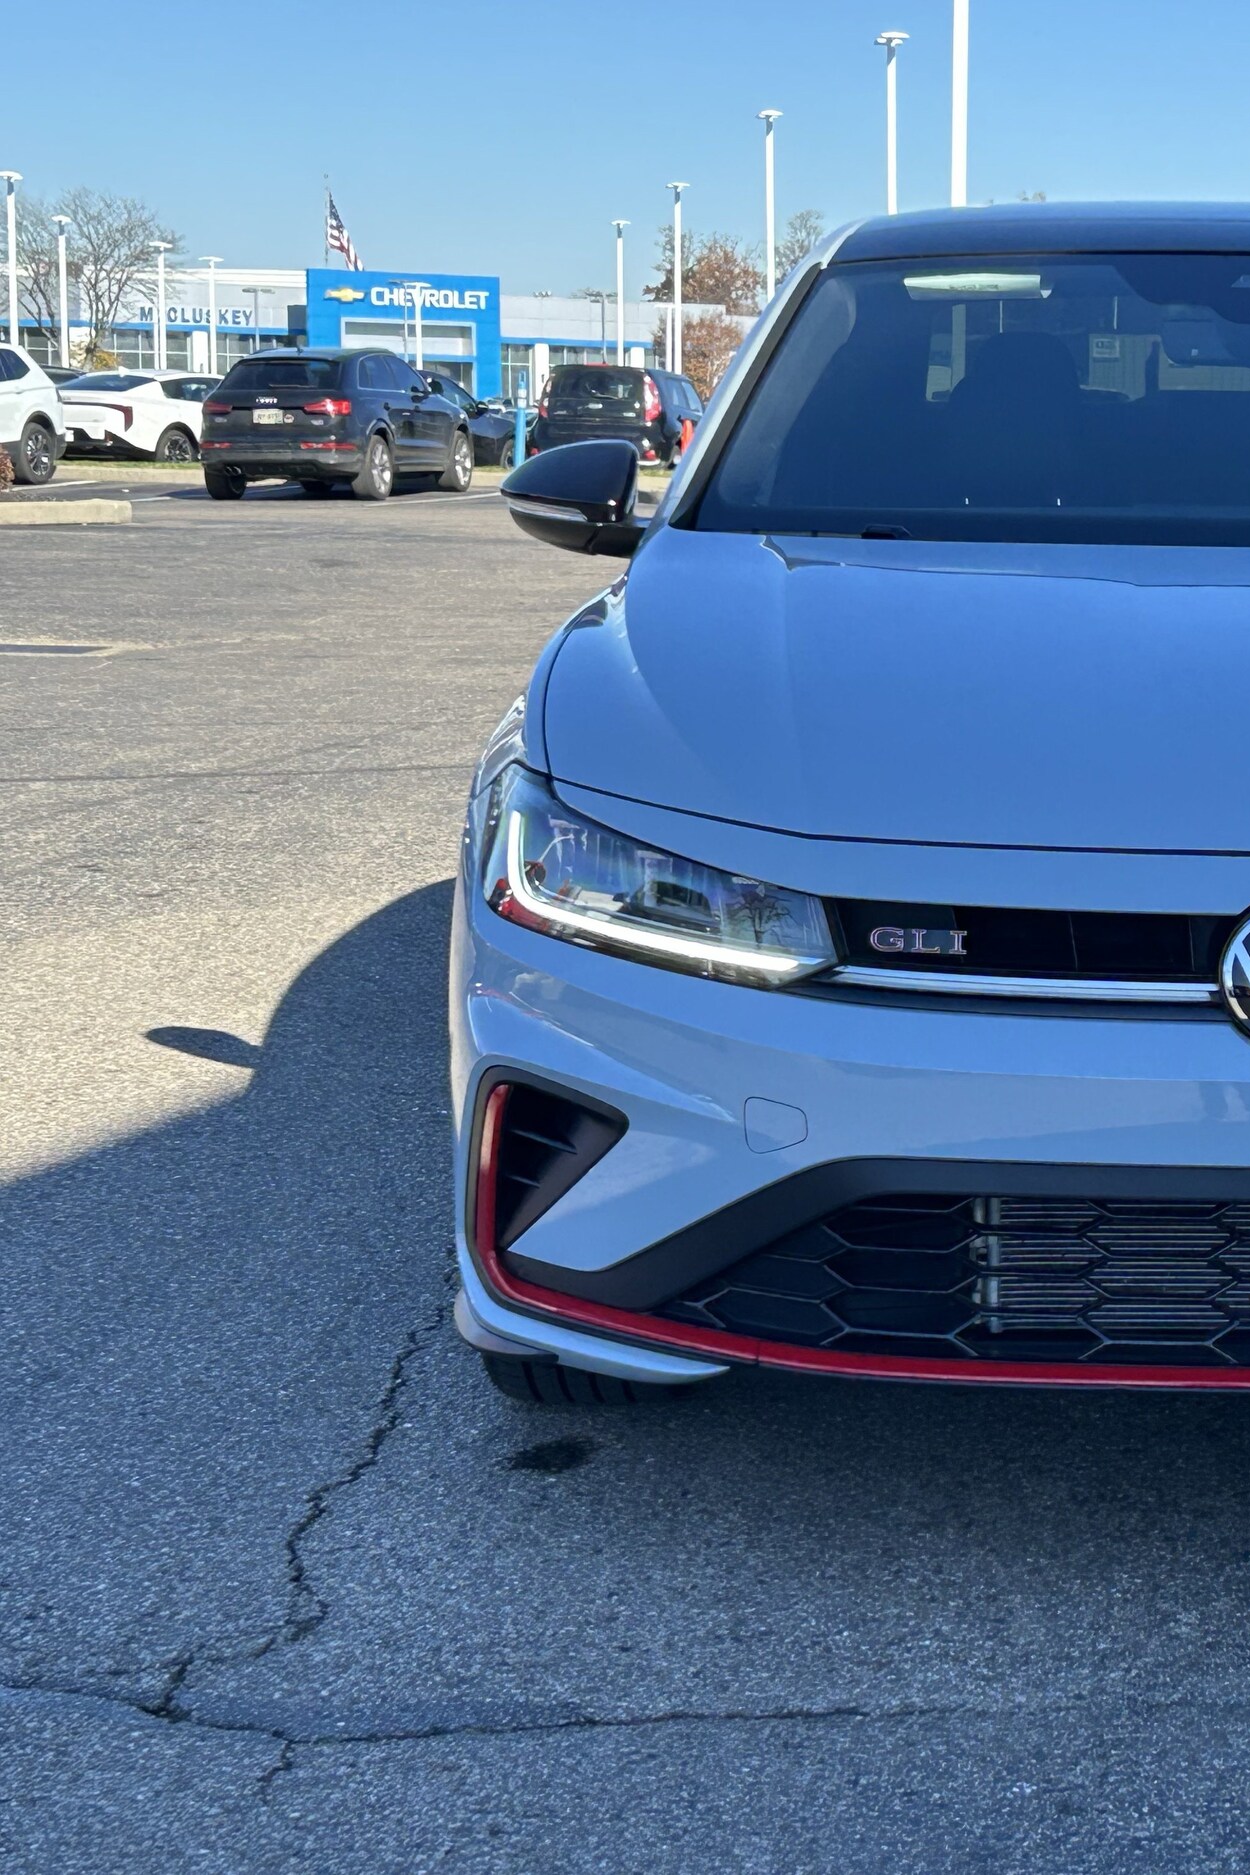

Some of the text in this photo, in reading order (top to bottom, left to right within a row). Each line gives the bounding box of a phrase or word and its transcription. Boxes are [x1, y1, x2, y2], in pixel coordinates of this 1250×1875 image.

[371, 287, 489, 309] CHEVROLET
[140, 306, 252, 326] MCLUSKEY
[870, 927, 967, 954] GLI
